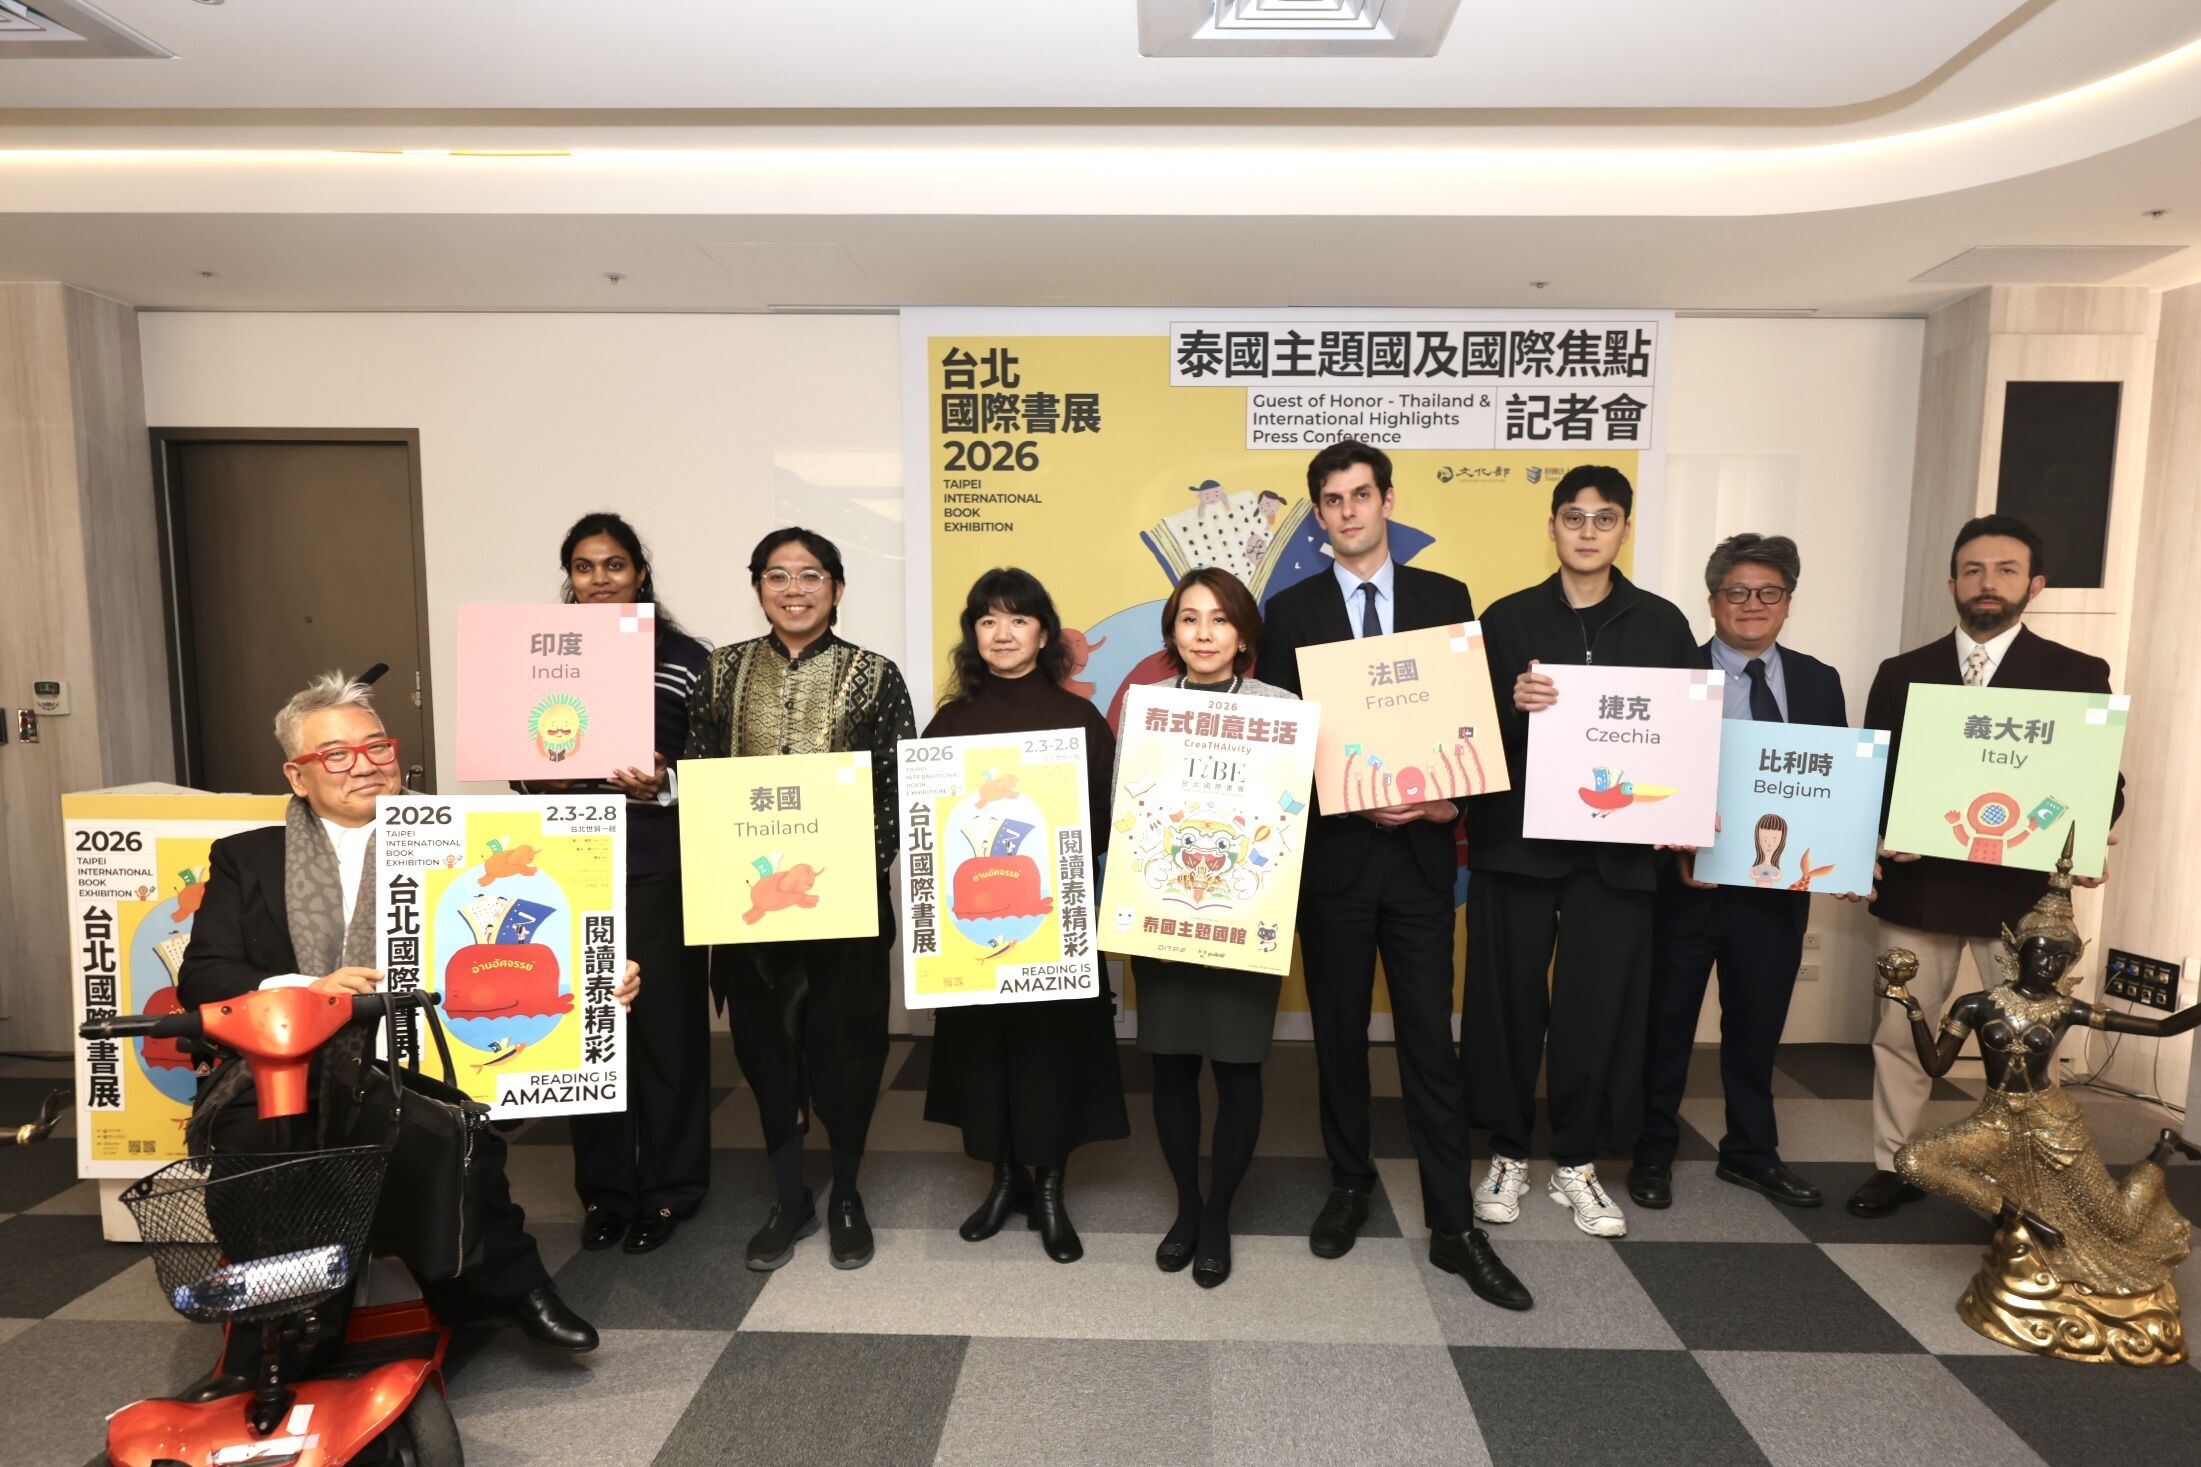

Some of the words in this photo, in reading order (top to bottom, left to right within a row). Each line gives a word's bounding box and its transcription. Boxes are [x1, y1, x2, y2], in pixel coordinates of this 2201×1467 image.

[1177, 329, 1652, 379] 泰國主題國及國際焦點
[941, 347, 1021, 390] 台北
[1253, 394, 1302, 408] Guest
[1308, 393, 1325, 408] of
[1330, 394, 1383, 408] Honor
[1399, 393, 1474, 408] Thailand
[1479, 394, 1491, 408] &
[940, 392, 1102, 434] 國際書展
[1253, 411, 1364, 426] International
[1369, 411, 1460, 429] Highlights
[1506, 393, 1647, 442] 記者會
[1253, 430, 1298, 444] Press
[1302, 429, 1401, 444] Conference
[943, 441, 1040, 472] 2026
[1456, 466, 1510, 478] 文化部
[943, 479, 982, 489] TAIPEI
[943, 493, 1042, 504] INTERNATIONAL
[943, 508, 980, 518] BOOK
[943, 522, 1014, 532] EXHIBITION
[530, 632, 583, 657] 印度
[532, 664, 581, 680] India
[1368, 658, 1419, 686] 法國
[1208, 700, 1238, 711] 2026
[1365, 689, 1430, 710] France
[1599, 694, 1651, 721] 捷克
[1144, 707, 1297, 745] 泰式創意生活
[1585, 727, 1661, 744] Czechia
[1963, 714, 2055, 745] 義大利
[904, 745, 954, 763] 2026
[1024, 737, 1080, 753] 2.3-2.8
[1758, 748, 1833, 777] 比利時
[1981, 748, 2028, 769] Italy
[1754, 779, 1831, 799] Belgium
[749, 786, 802, 812] 泰國
[385, 806, 452, 825] 2026
[546, 806, 617, 822] 2.3-2.8
[734, 818, 819, 838] Thailand
[75, 830, 143, 852] 2026
[386, 839, 461, 847] INTERNATIONAL
[77, 857, 107, 865] TAIPEI
[386, 858, 440, 867] EXHIBITION
[78, 867, 153, 877] INTERNATIONAL
[908, 802, 937, 954] 台北國際書展
[78, 879, 107, 887] BOOK
[79, 889, 132, 898] EXHIBITION
[1059, 830, 1089, 958] 閱讀泰精彩
[1143, 916, 1247, 945] 泰國主題國館
[1022, 965, 1077, 976] READING
[1081, 963, 1091, 973] IS
[584, 916, 616, 1064] 閱讀泰精彩
[1000, 974, 1091, 994] AMAZING
[530, 1072, 600, 1086] READING
[604, 1071, 617, 1083] IS
[500, 1085, 617, 1106] AMAZING
